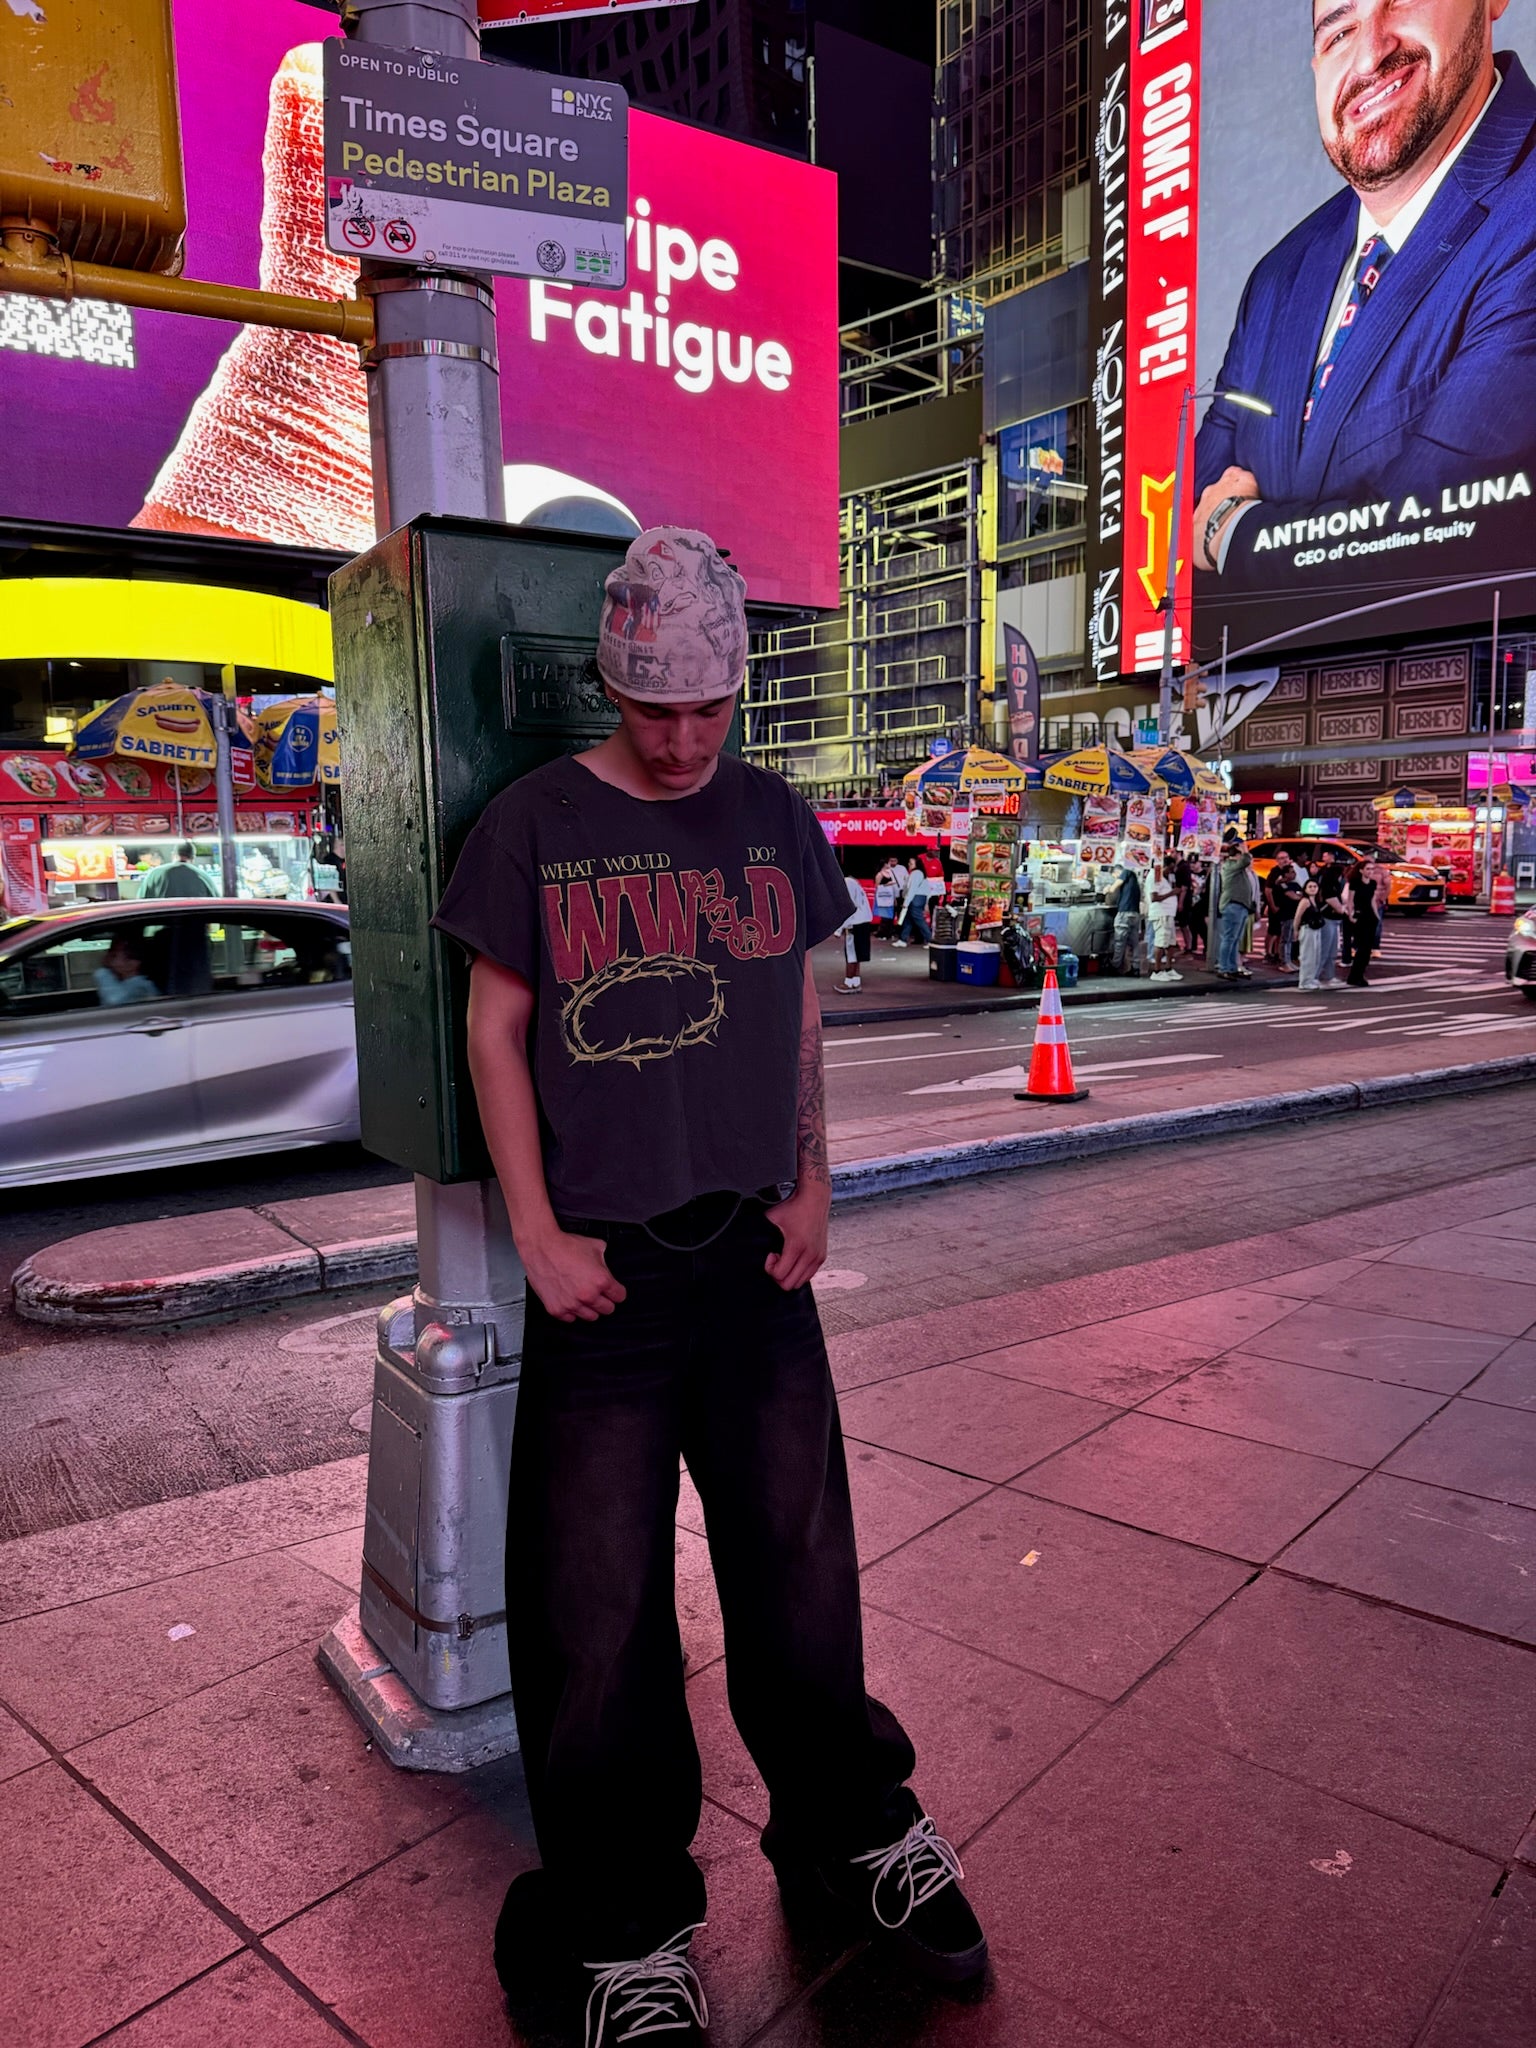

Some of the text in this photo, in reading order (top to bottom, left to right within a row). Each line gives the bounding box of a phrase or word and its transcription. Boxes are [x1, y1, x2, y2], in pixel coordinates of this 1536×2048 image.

[339, 54, 459, 85] OPEN TO PUBLIC
[576, 91, 613, 112] NYC
[576, 107, 613, 122] PLAZA
[340, 95, 580, 162] Times Square
[1141, 62, 1193, 210] COME
[342, 141, 611, 208] Pedestrian Plaza
[1103, 62, 1127, 301] EDITION
[626, 197, 740, 296] ipe
[528, 278, 793, 394] Fatigue
[1100, 319, 1124, 545] EDITION
[1253, 472, 1532, 553] ANTHONY A. LUNA
[1293, 520, 1477, 568] CEO of Coastline Equity
[1322, 667, 1380, 691] HERSHEY'S
[1401, 657, 1464, 682] HERSHEY'S
[1249, 722, 1301, 743] HERSHEY'S
[1320, 714, 1379, 737] HERSHEY'S
[1399, 706, 1463, 731] HERSHEY'S
[121, 735, 213, 763] SABRETT
[1398, 754, 1461, 773] HERSHEY'S
[1317, 760, 1378, 778] HERSHEY'S
[1046, 774, 1107, 794] SABRETT
[540, 847, 777, 882] WHAT WOULD DO?
